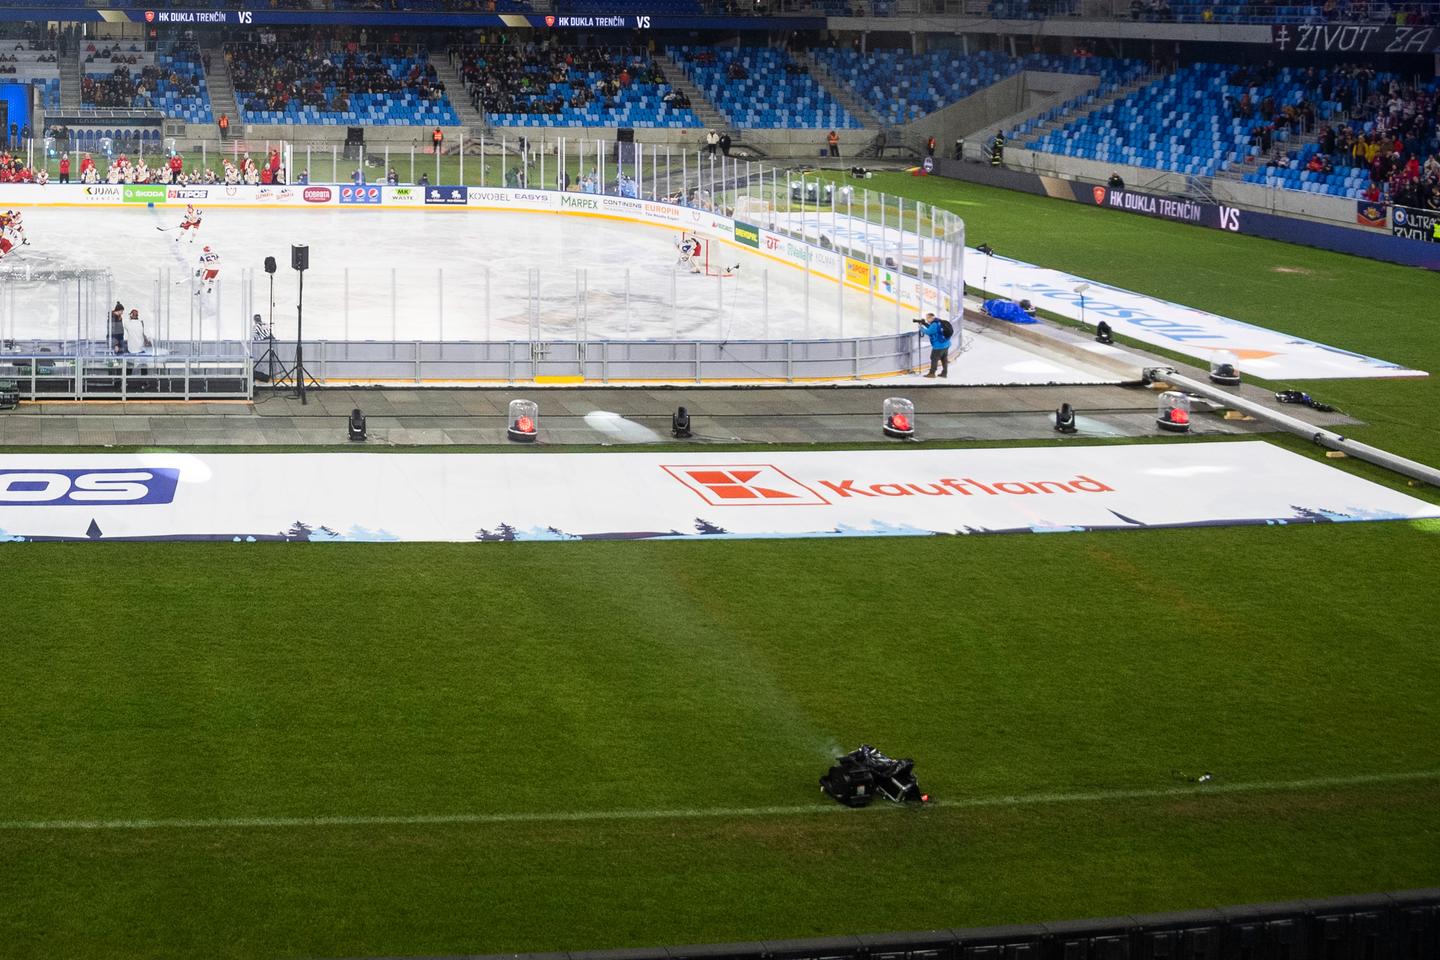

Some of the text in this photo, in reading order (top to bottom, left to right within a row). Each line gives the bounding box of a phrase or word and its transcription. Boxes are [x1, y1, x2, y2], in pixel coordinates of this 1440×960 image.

[158, 11, 252, 23] HK DUKLA TRENČÍN VS
[558, 16, 651, 28] HK DUKLA TRENČÍN VS
[1296, 24, 1380, 51] ŽIVOT
[94, 187, 120, 195] JUMA
[468, 192, 510, 201] KOVOBEL
[1110, 191, 1240, 231] HK DUKLA TRENČÍN VS
[818, 475, 1115, 498] Kaufland
